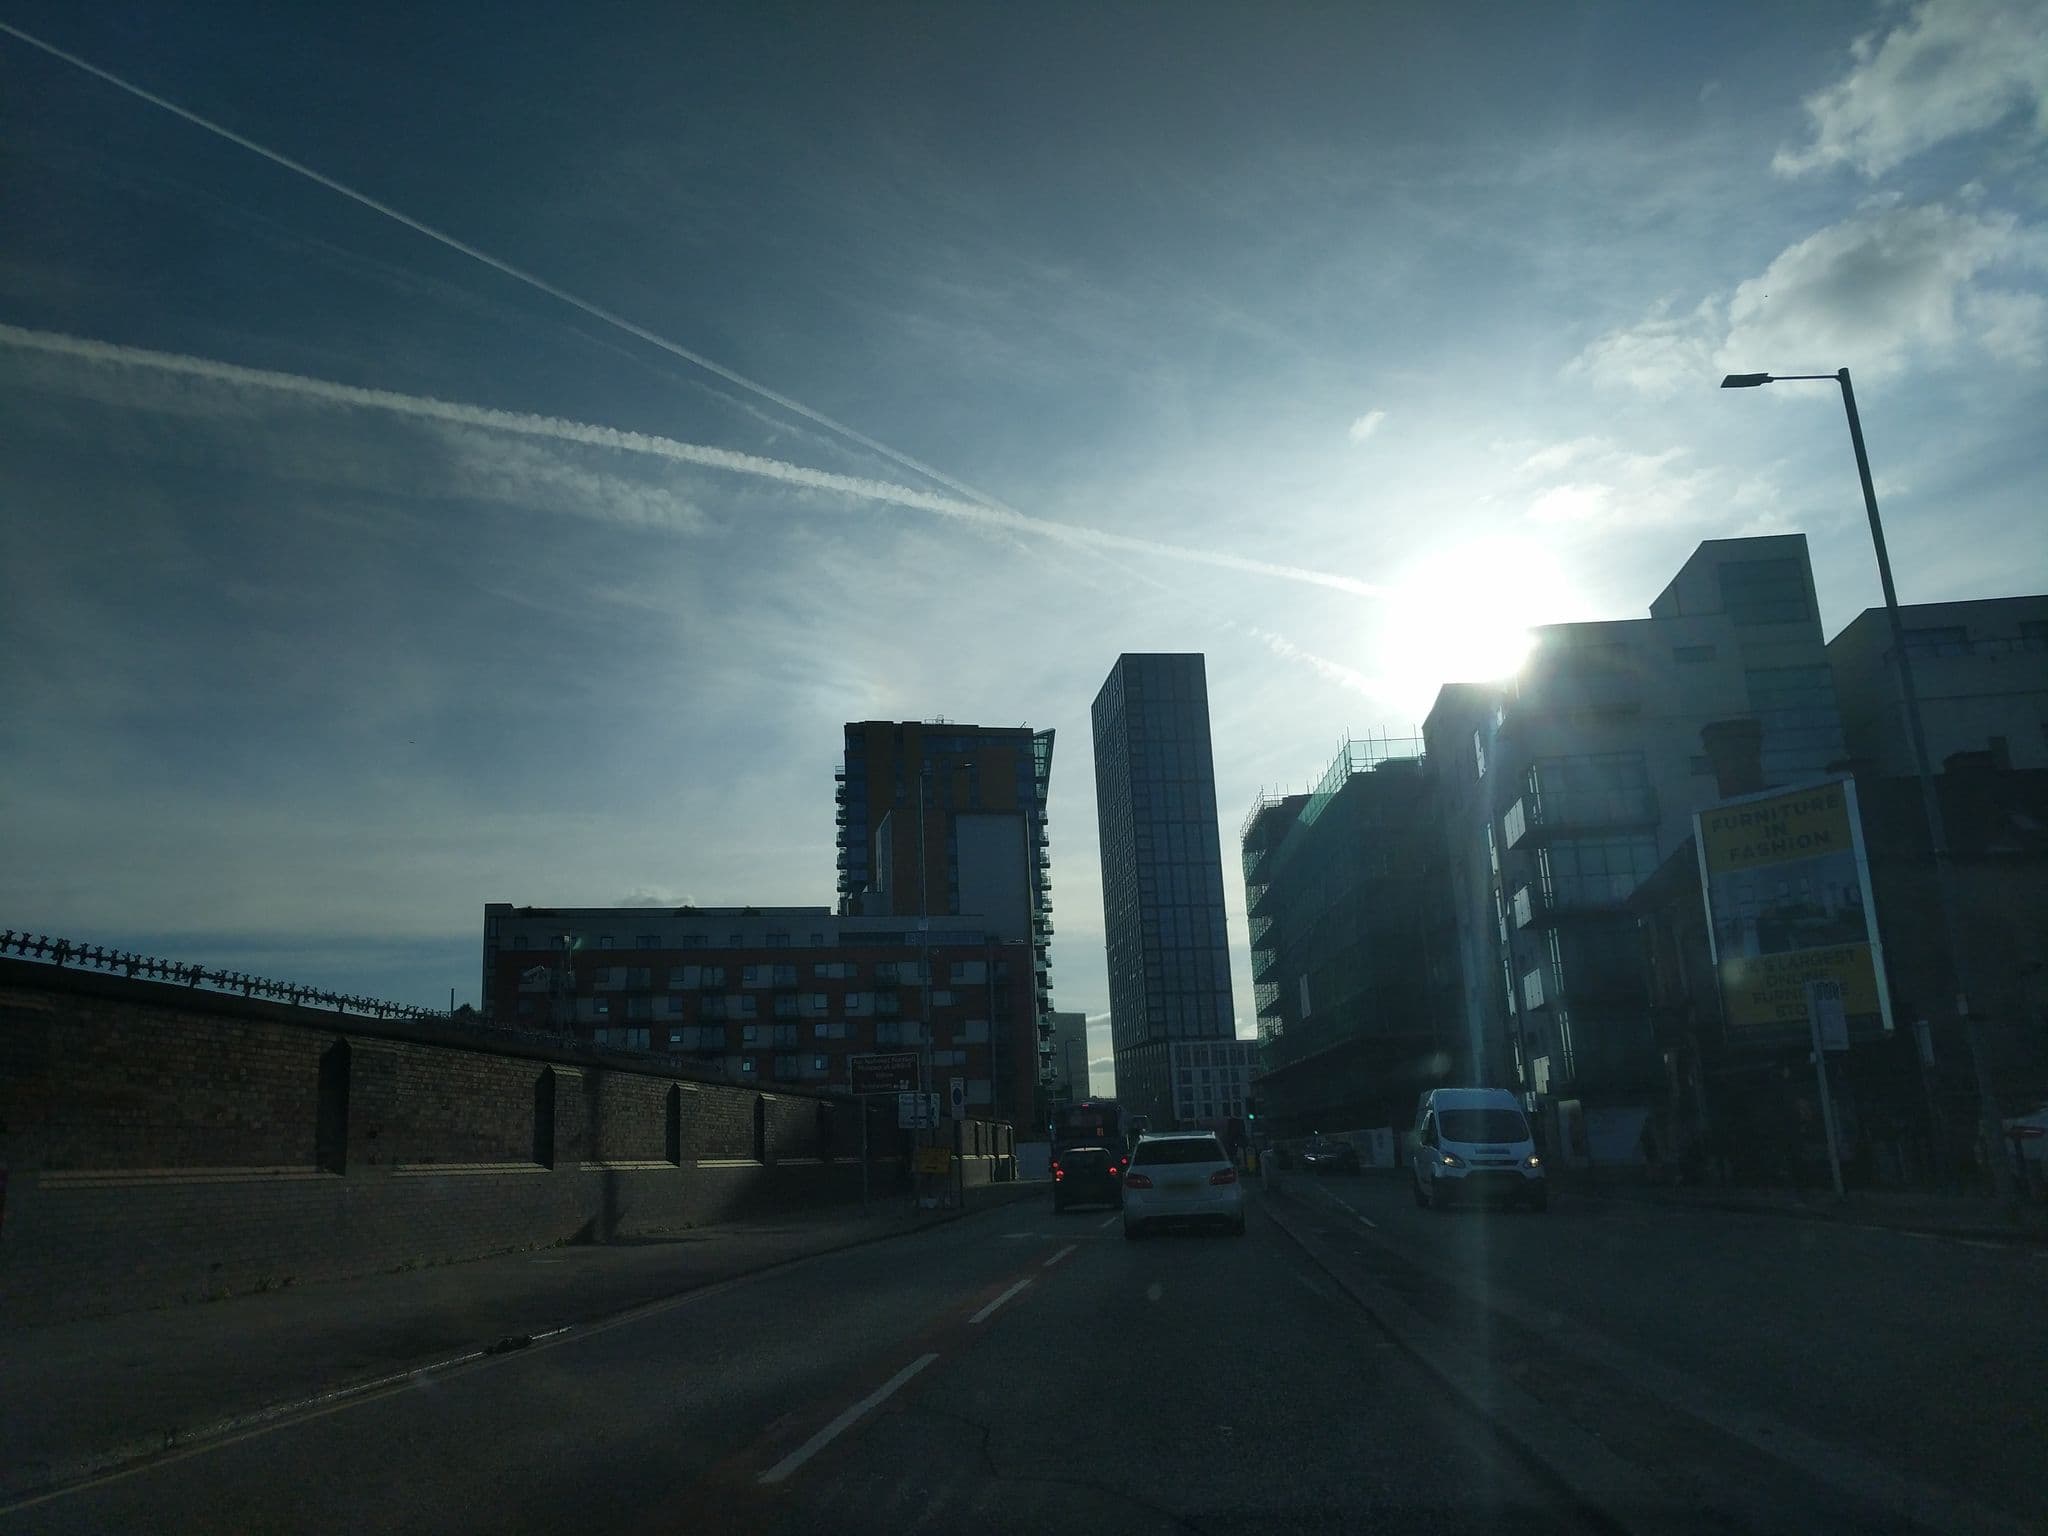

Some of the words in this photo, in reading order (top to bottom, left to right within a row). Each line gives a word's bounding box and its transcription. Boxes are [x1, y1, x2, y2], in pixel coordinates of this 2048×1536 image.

[1711, 795, 1839, 833] FURNITURE
[1729, 831, 1830, 862] FASHION
[1763, 823, 1787, 841] IN
